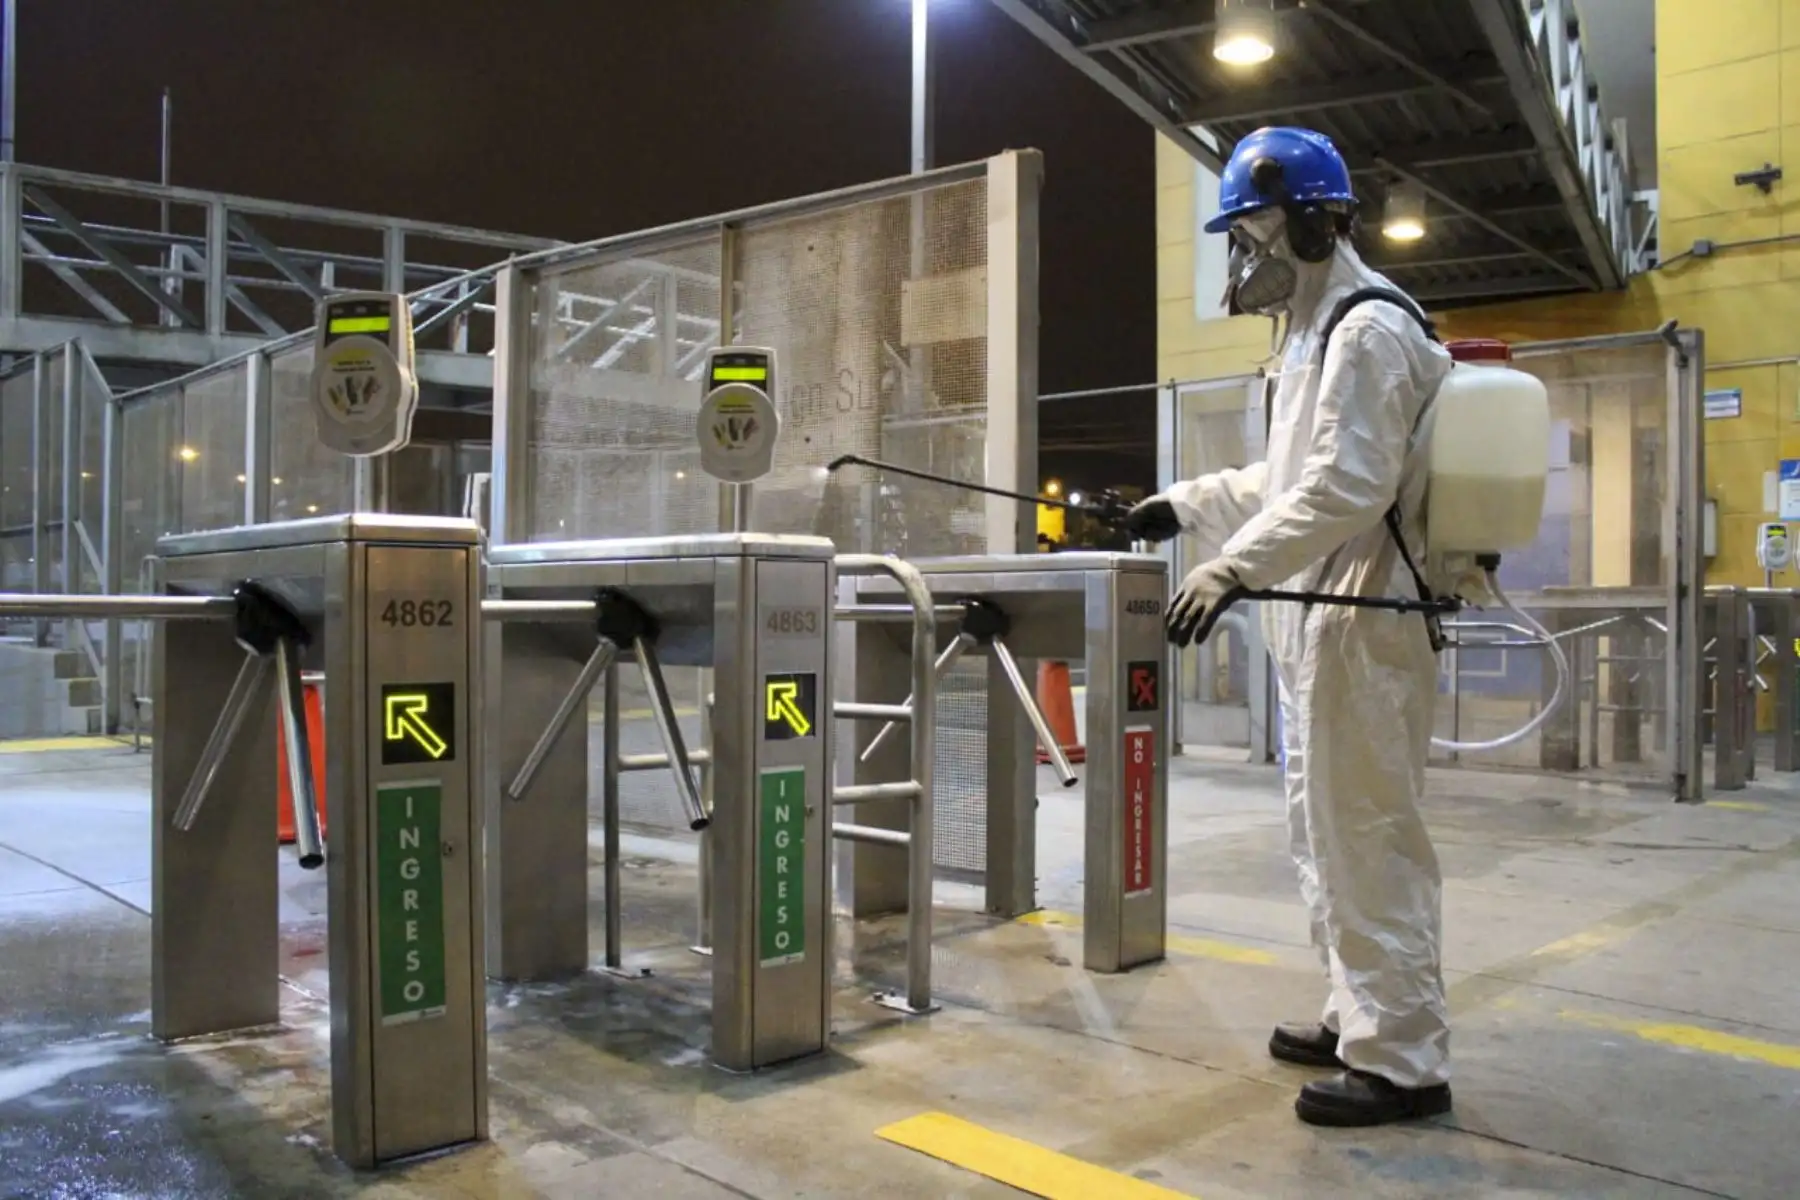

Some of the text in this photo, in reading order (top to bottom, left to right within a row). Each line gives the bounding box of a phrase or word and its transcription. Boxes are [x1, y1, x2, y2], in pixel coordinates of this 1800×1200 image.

[381, 599, 453, 627] 4862
[767, 610, 817, 633] 4863
[774, 779, 791, 949] INGRESO
[1133, 737, 1143, 885] NO INGRESAR
[399, 796, 425, 1002] INGRESO
